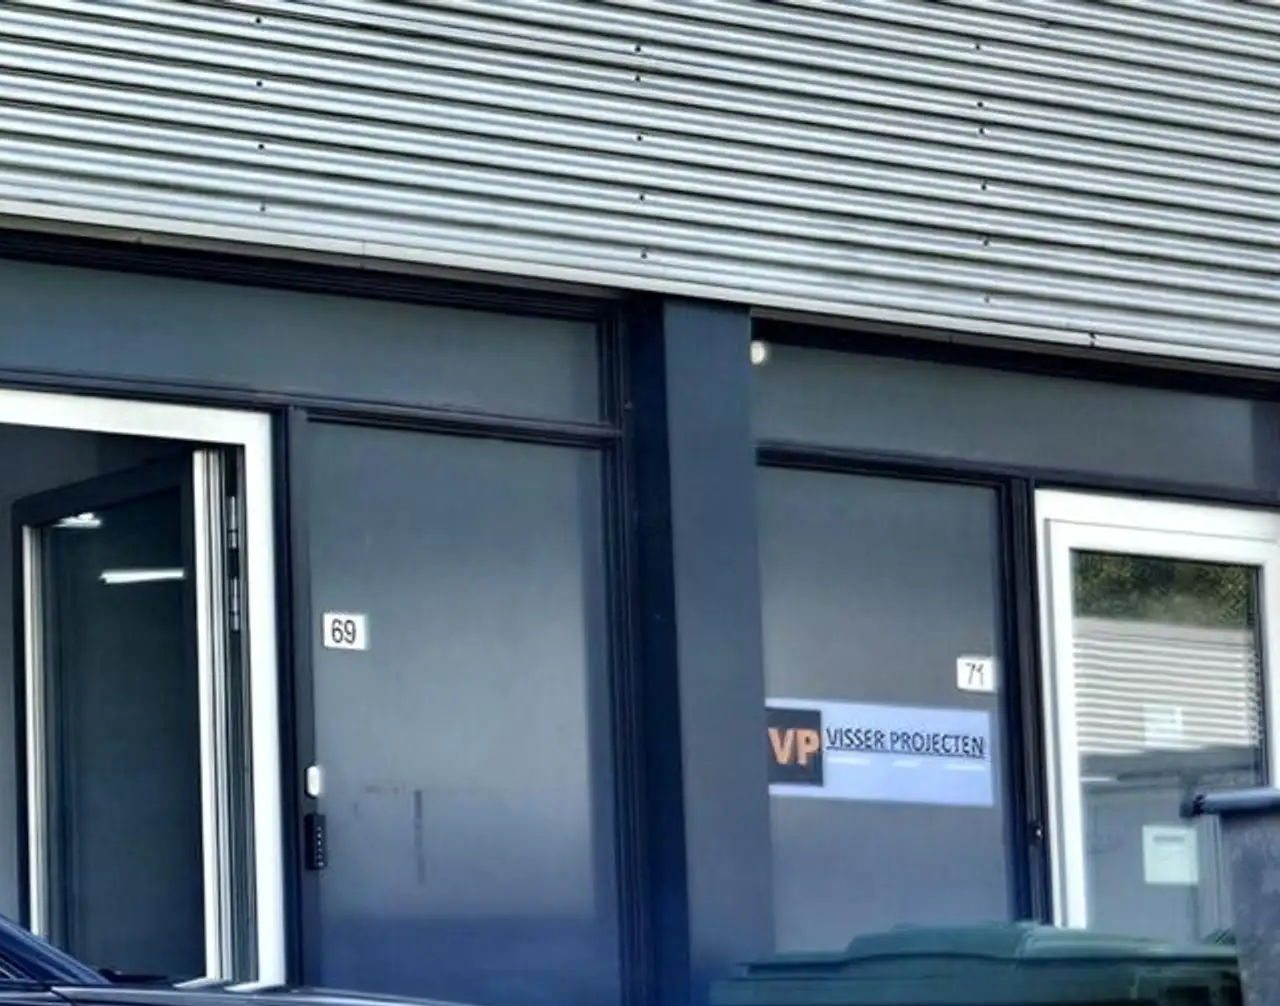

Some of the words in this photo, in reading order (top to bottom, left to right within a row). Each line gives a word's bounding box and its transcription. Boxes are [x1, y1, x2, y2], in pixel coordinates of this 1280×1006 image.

[331, 618, 357, 644] 69
[965, 661, 985, 686] 71
[767, 727, 821, 766] VP
[826, 727, 885, 750] VISSER
[890, 731, 985, 756] PROJECTEN
